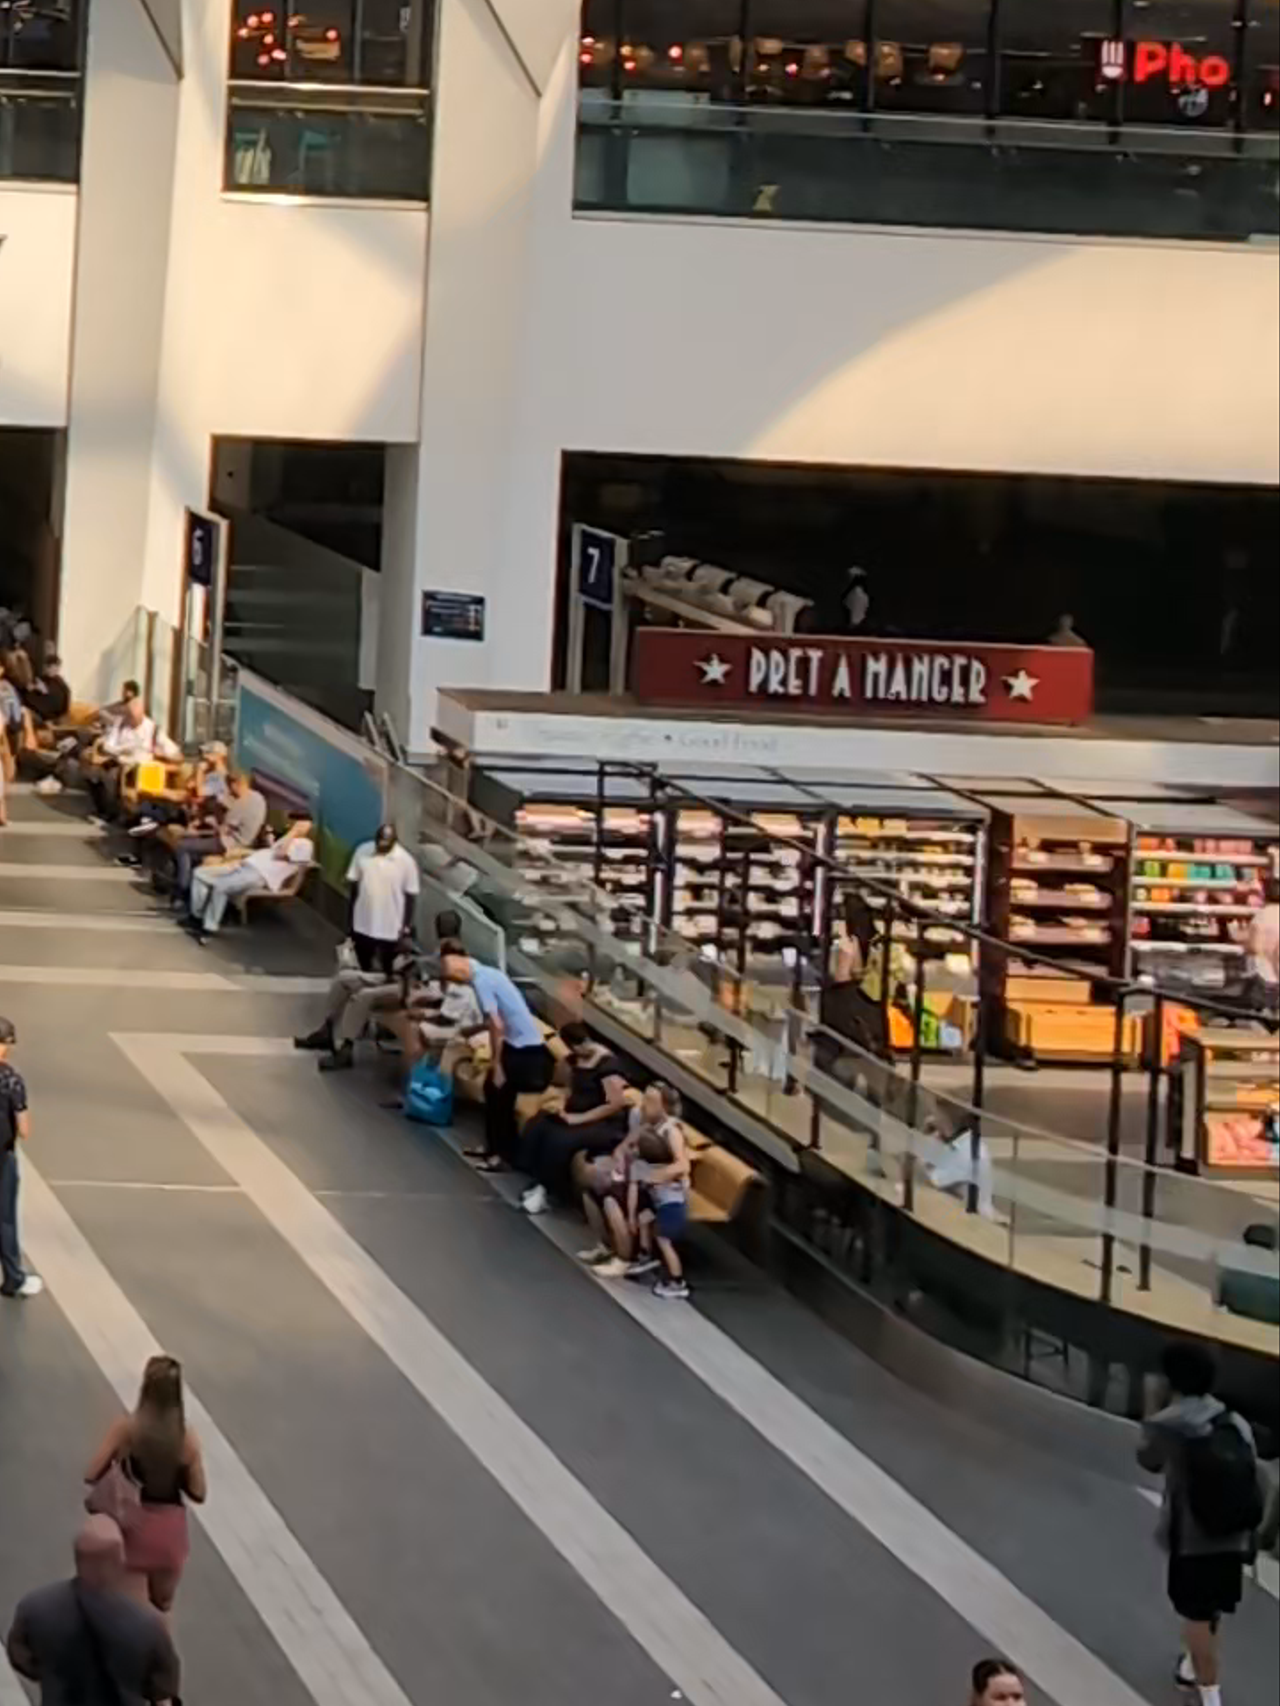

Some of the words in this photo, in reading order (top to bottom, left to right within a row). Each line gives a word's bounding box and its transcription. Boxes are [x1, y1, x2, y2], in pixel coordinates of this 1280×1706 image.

[1133, 41, 1229, 87] Pho
[586, 546, 601, 584] 7
[748, 646, 824, 697] PRET
[832, 651, 852, 698] A
[864, 651, 987, 704] MANGER
